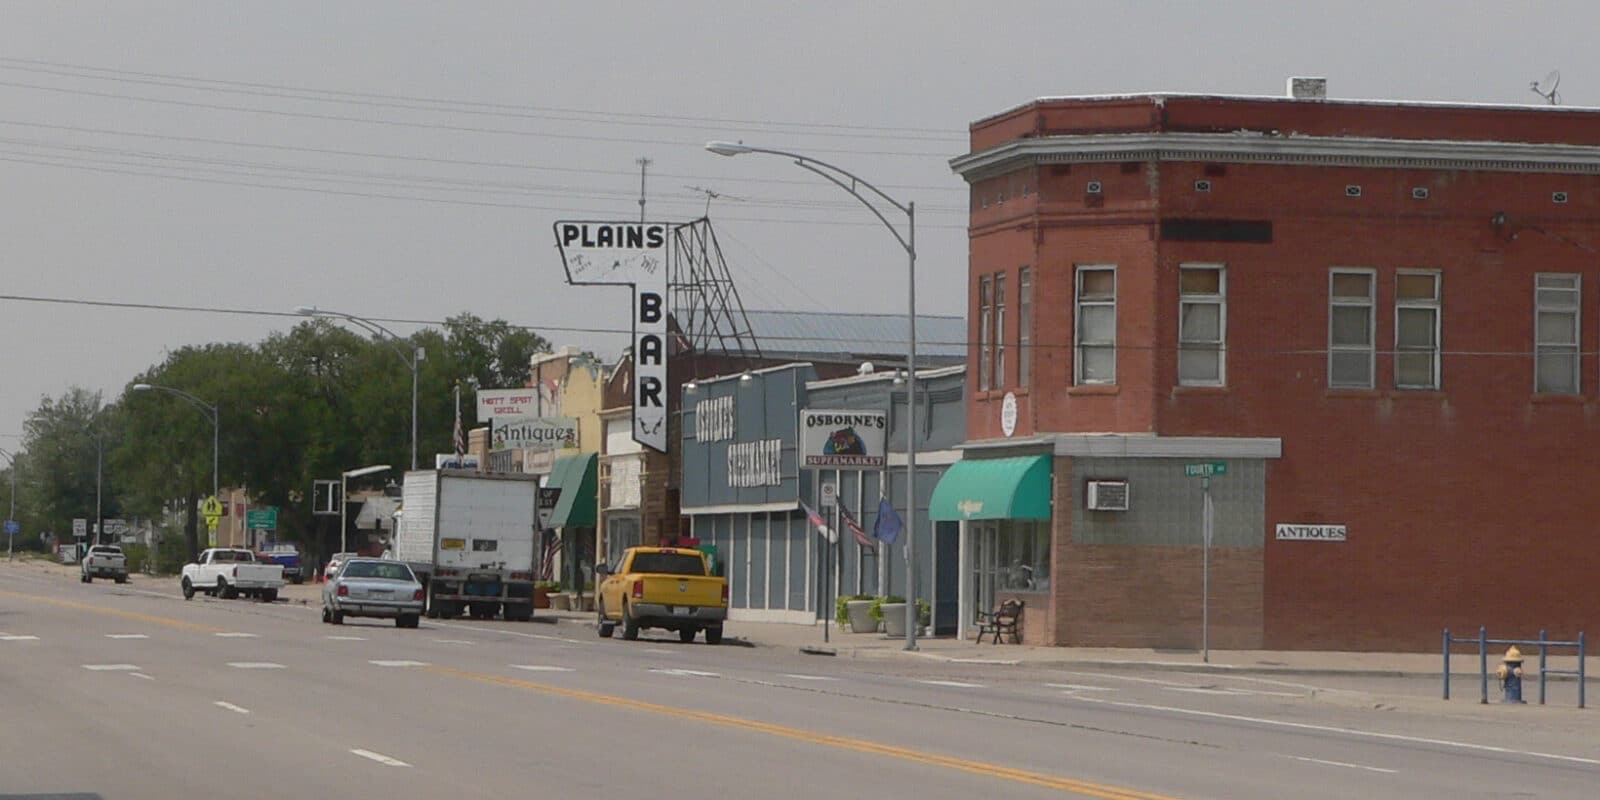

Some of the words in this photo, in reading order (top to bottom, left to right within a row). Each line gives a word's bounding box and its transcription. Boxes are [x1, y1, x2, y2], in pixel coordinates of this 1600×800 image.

[563, 224, 664, 249] PLAINS
[640, 292, 663, 407] BAR
[806, 414, 885, 429] OSBORNE'S
[494, 424, 575, 442] Antiques
[807, 455, 883, 466] SUPERMARKET
[1278, 526, 1345, 538] ANTIQUES
